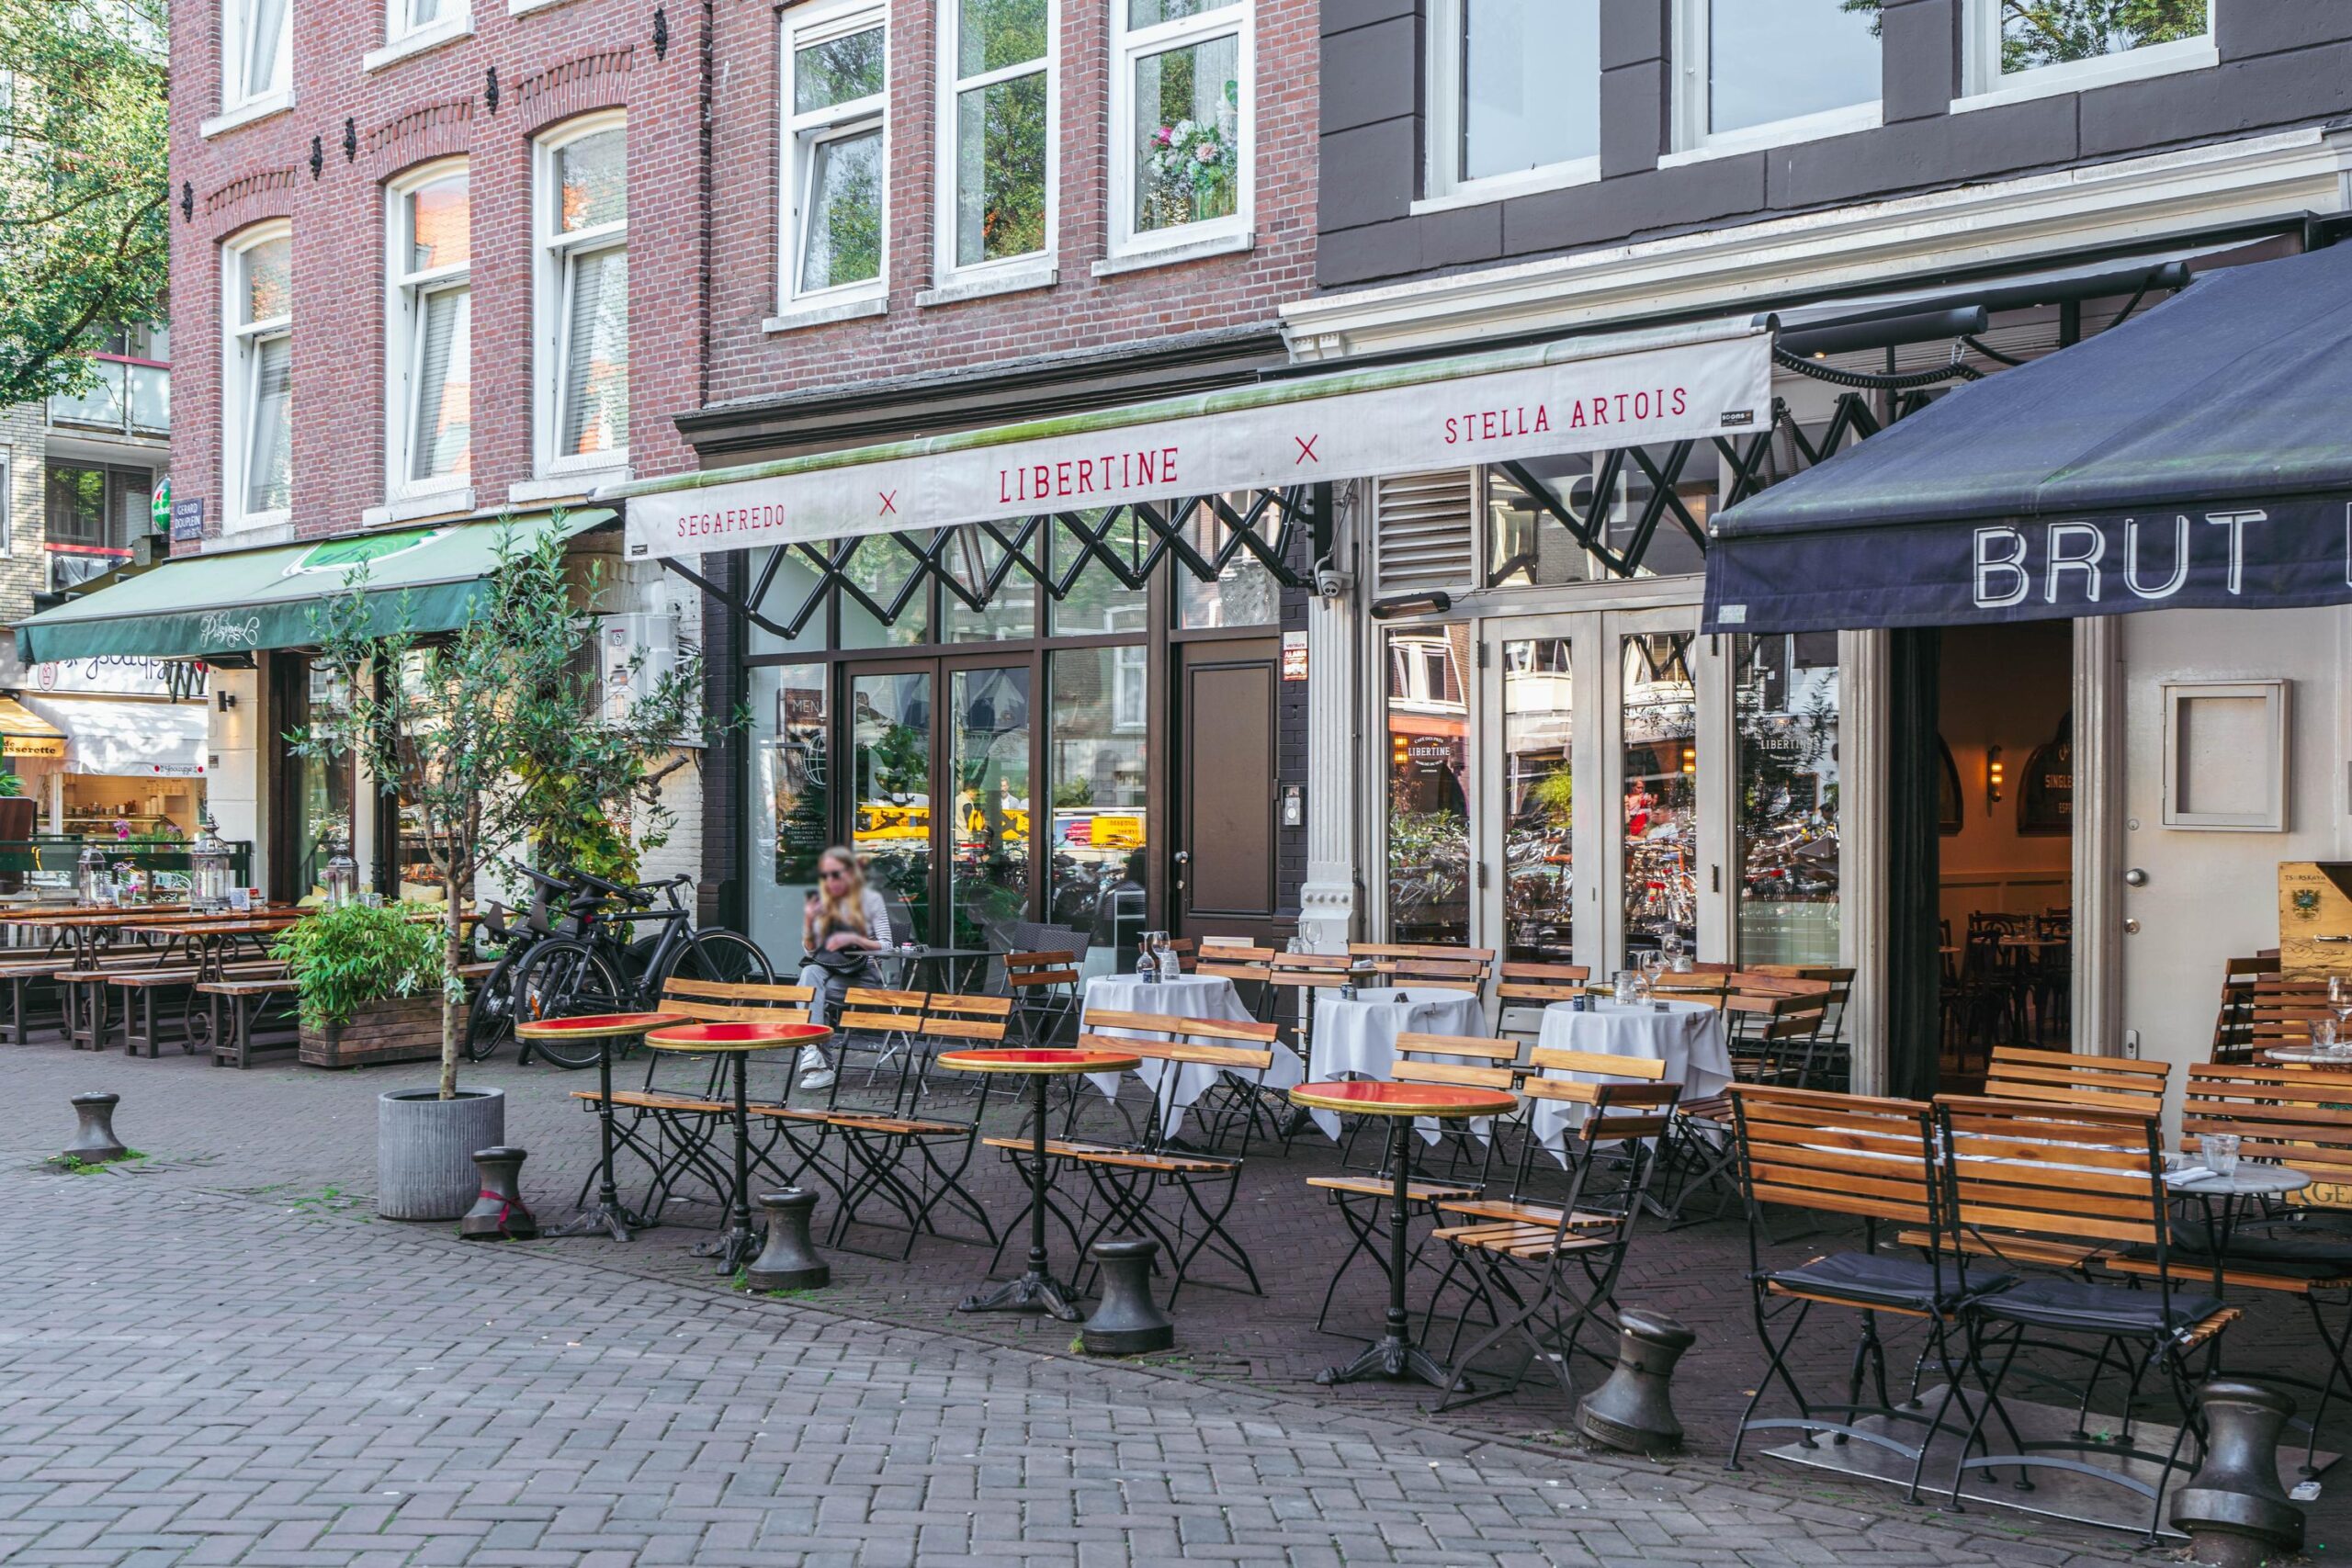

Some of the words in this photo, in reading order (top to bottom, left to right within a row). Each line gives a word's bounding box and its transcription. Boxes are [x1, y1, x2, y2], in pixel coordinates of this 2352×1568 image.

[678, 504, 785, 537] SEGAFREDO
[1000, 446, 1179, 503] LIBERTINE
[1445, 404, 1551, 445] STELLA
[1570, 387, 1688, 429] ARTOIS
[177, 502, 198, 515] GERARD
[175, 514, 201, 528] DOUPLEIN
[1973, 509, 2268, 609] BRUT
[792, 700, 820, 713] MEN
[1408, 747, 1451, 756] LIBERTINE
